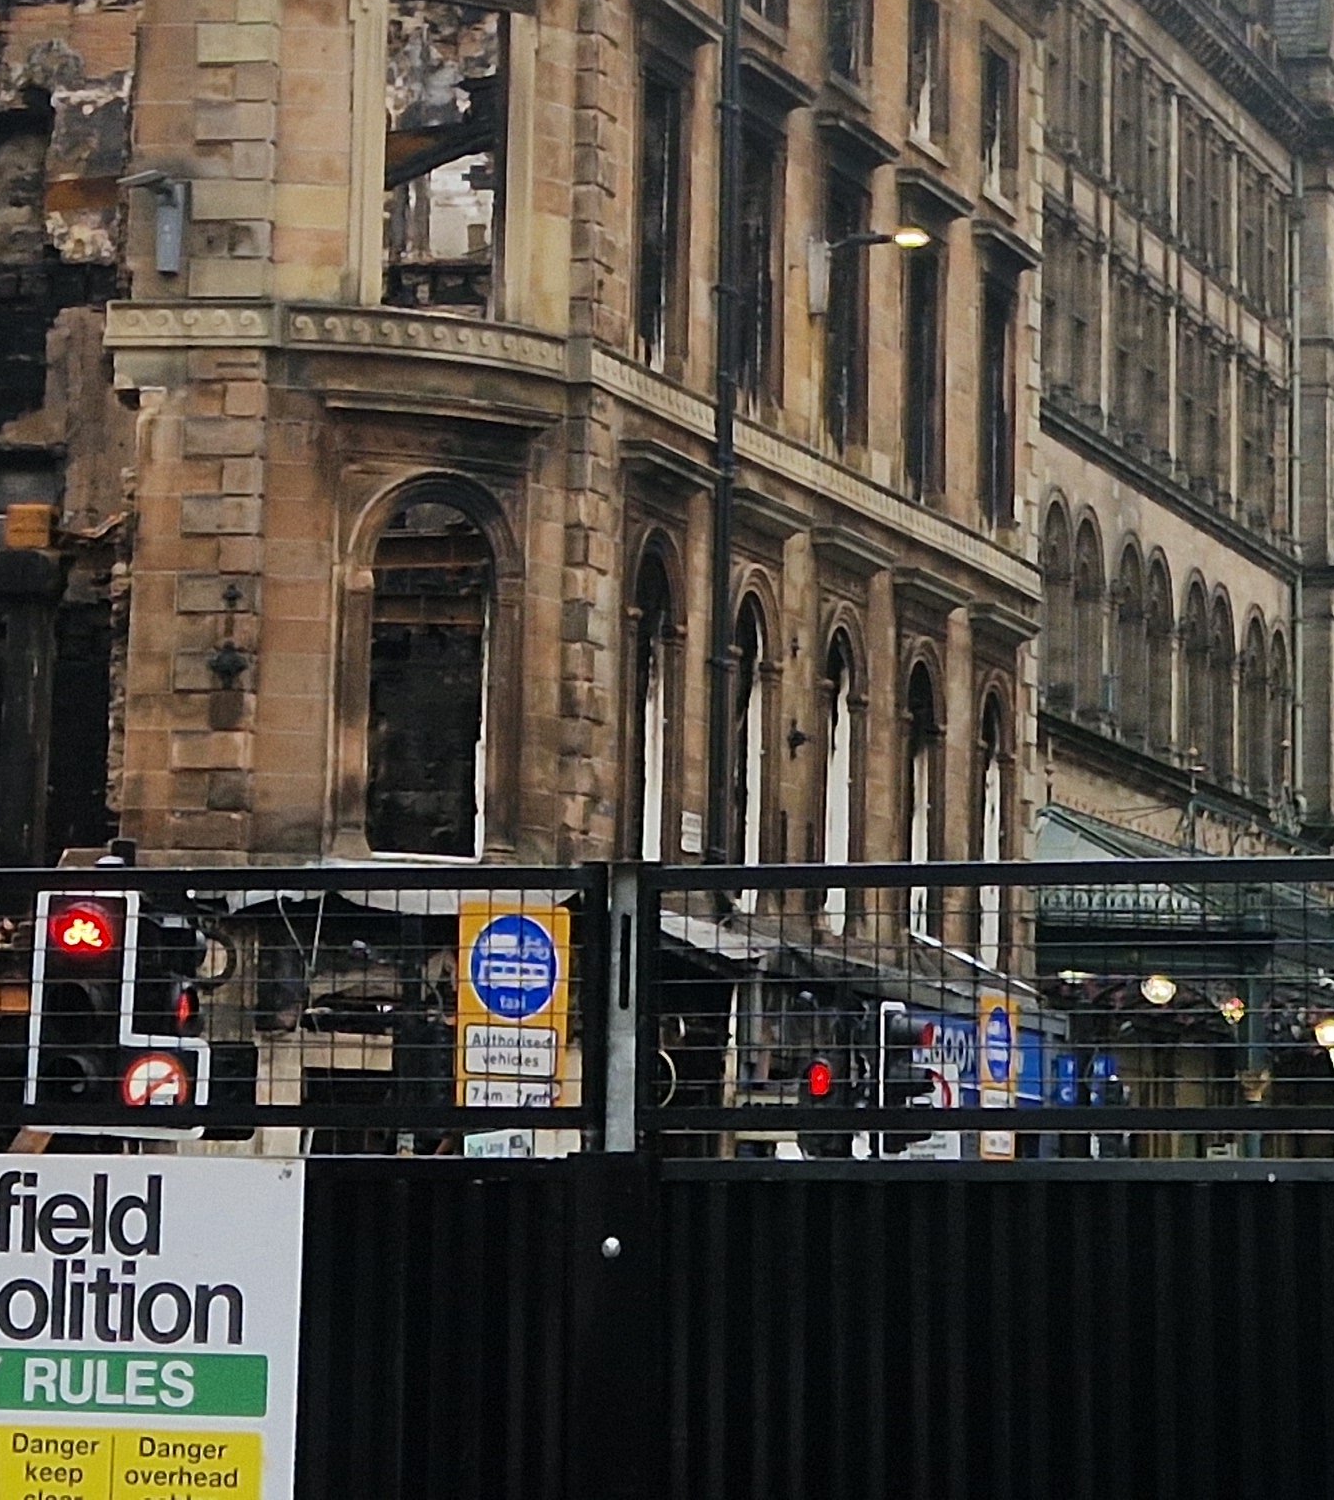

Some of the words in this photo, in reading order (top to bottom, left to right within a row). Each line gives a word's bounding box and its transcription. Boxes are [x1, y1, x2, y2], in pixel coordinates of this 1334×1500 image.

[472, 1032, 553, 1048] Authoised
[481, 1051, 540, 1068] vehices
[23, 1358, 195, 1408] RULES
[11, 1432, 100, 1458] Danger
[138, 1436, 228, 1462] Danger
[25, 1461, 84, 1487] keep
[124, 1466, 239, 1488] overhead
